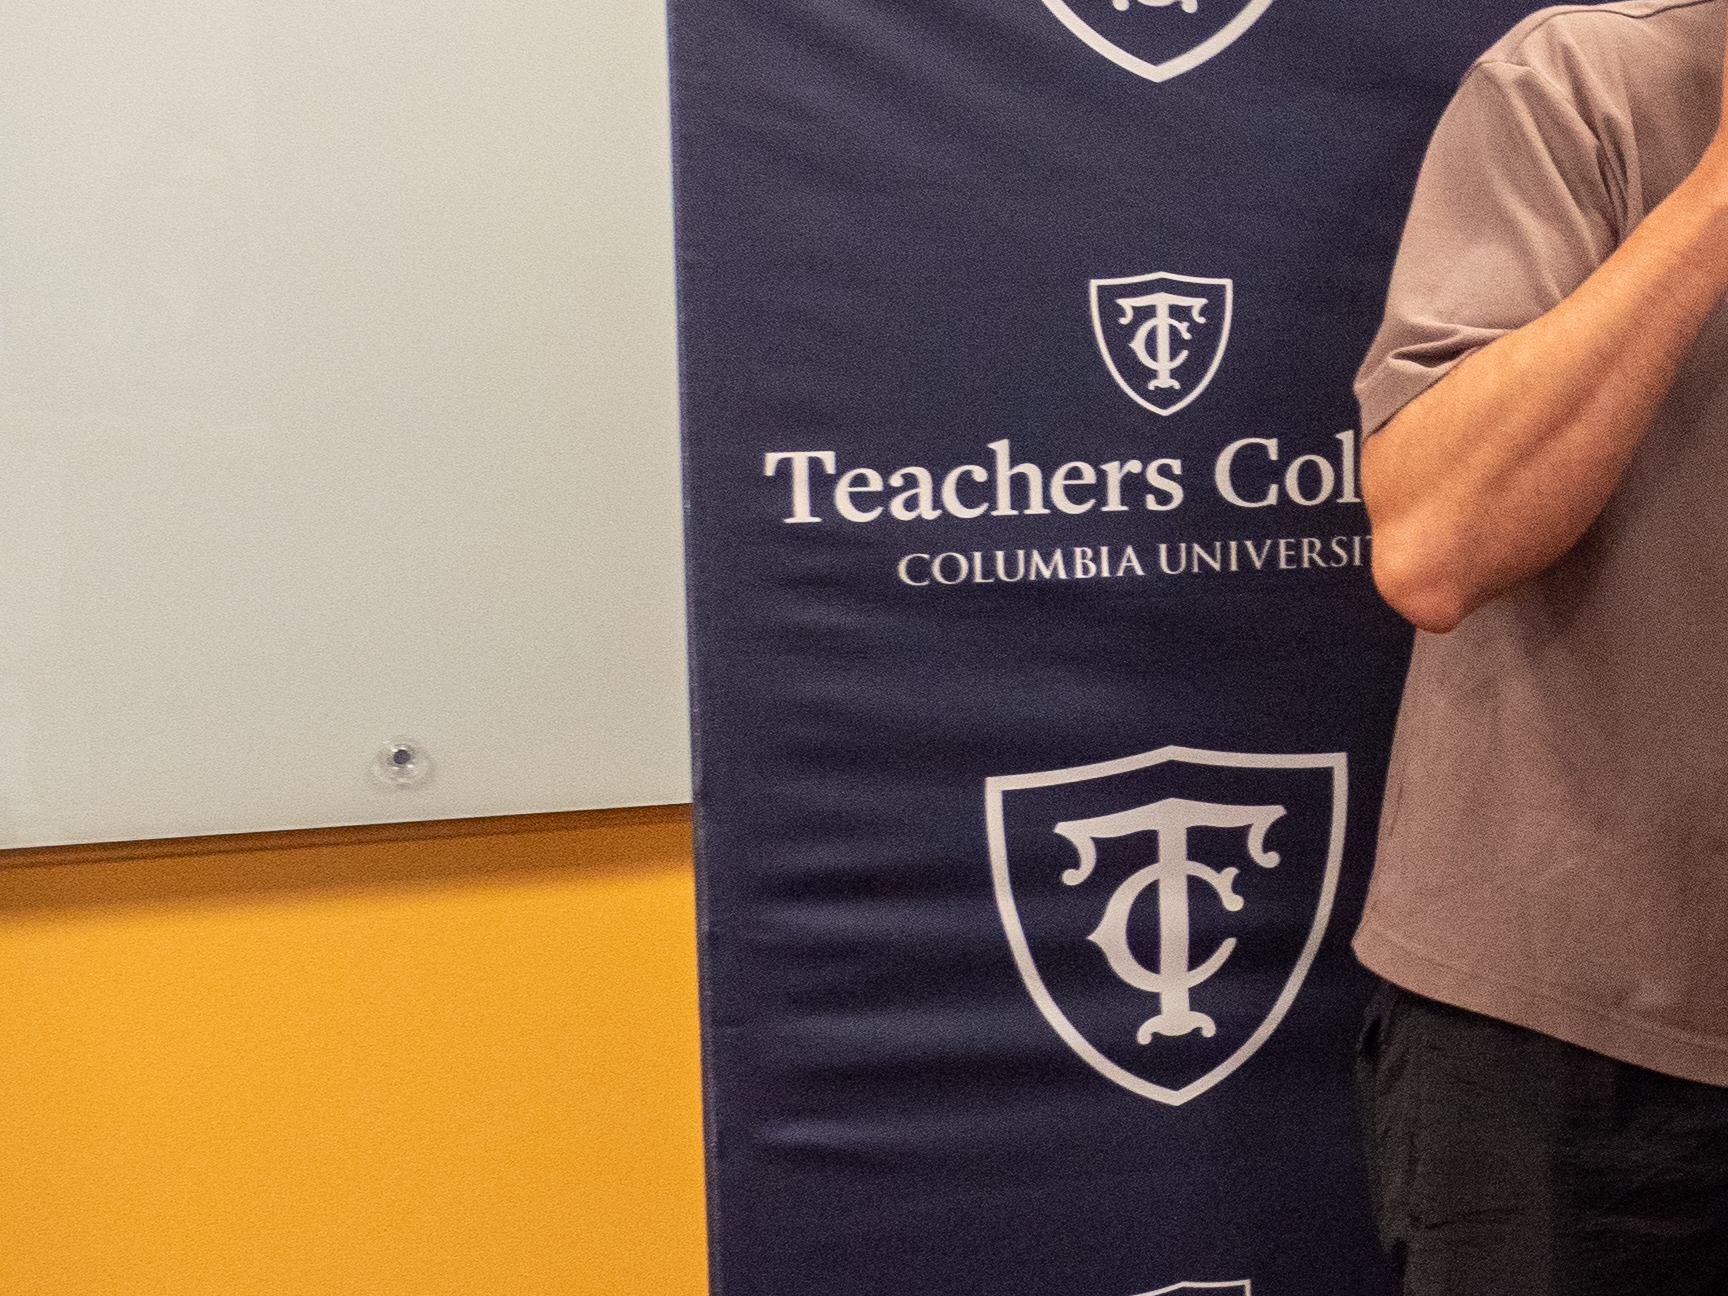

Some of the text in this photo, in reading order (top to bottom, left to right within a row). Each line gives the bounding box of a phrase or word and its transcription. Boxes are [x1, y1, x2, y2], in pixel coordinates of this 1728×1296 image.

[762, 438, 1183, 525] Teachers
[897, 534, 1373, 587] COLUMBIA UNIVERSI
